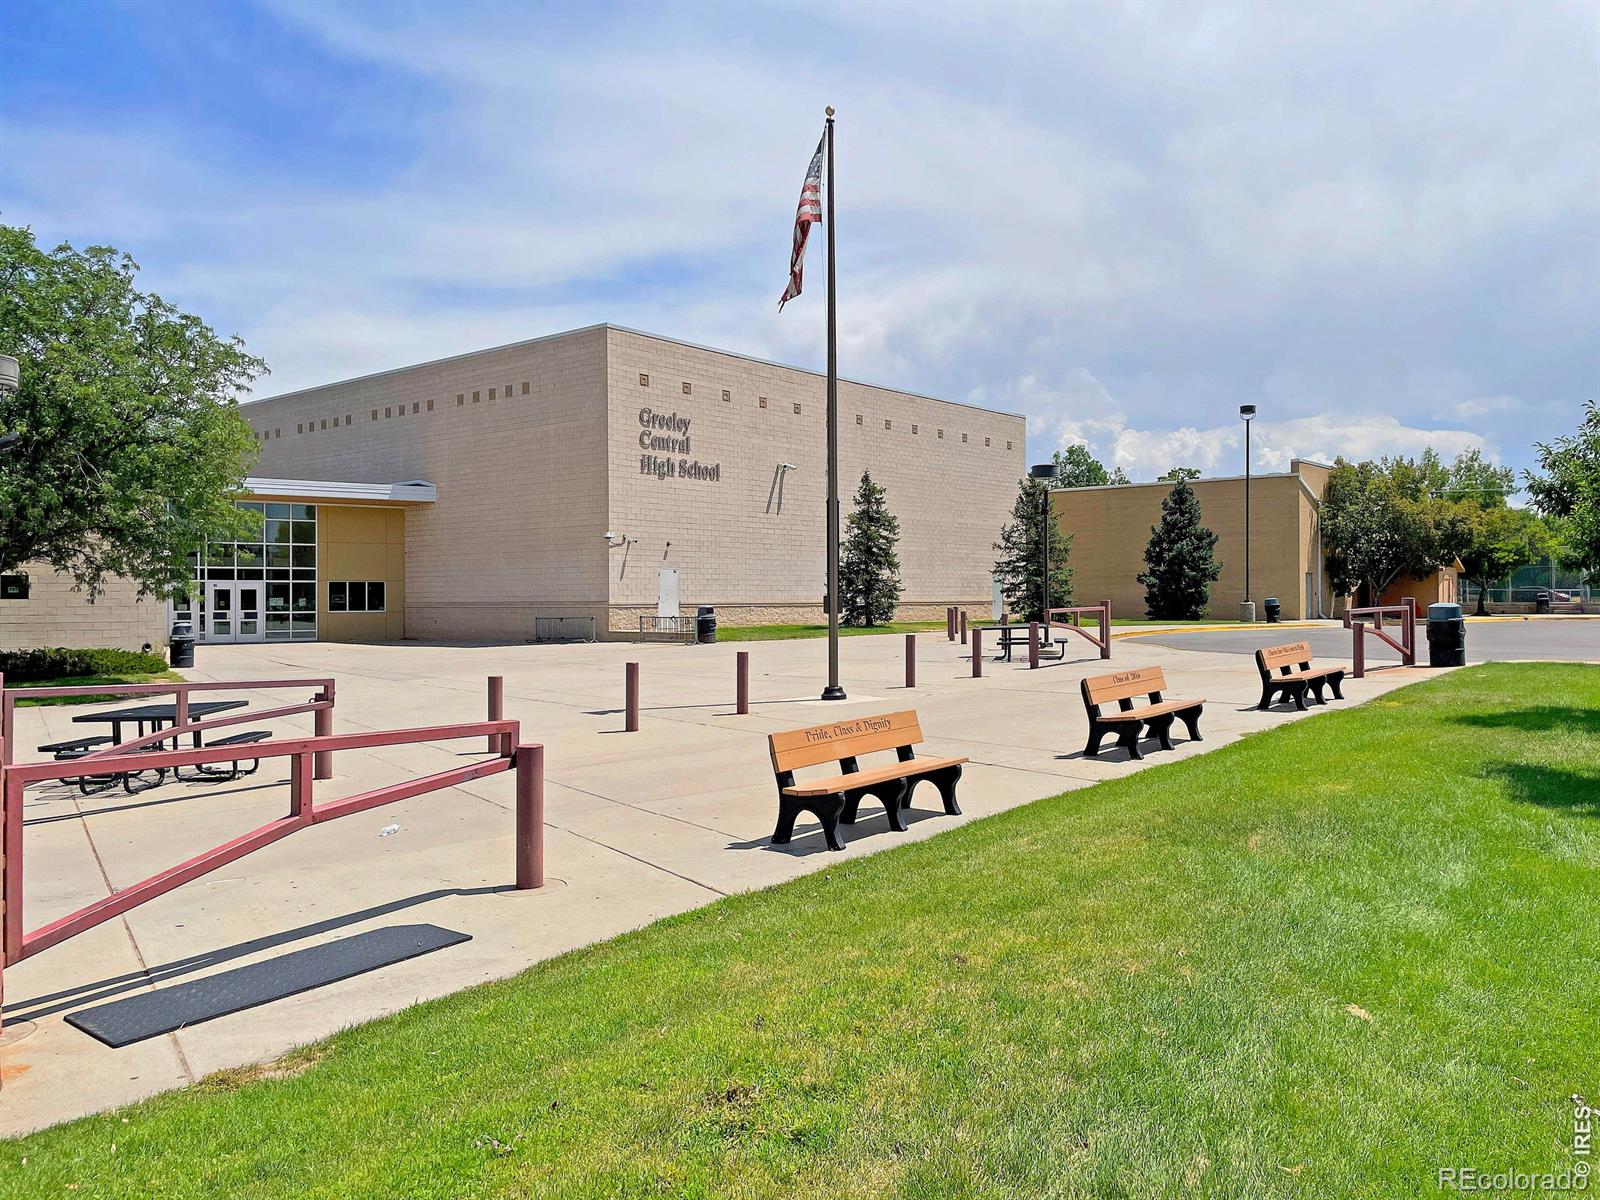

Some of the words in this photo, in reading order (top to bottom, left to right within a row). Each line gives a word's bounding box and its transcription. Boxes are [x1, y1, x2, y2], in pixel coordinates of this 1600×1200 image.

[639, 407, 691, 437] Greeley
[639, 429, 691, 455] Central
[640, 454, 675, 480] High
[678, 458, 720, 482] School
[805, 728, 832, 742] Pride,
[833, 725, 854, 737] Class
[855, 722, 862, 732] &
[863, 717, 892, 733] Dignity
